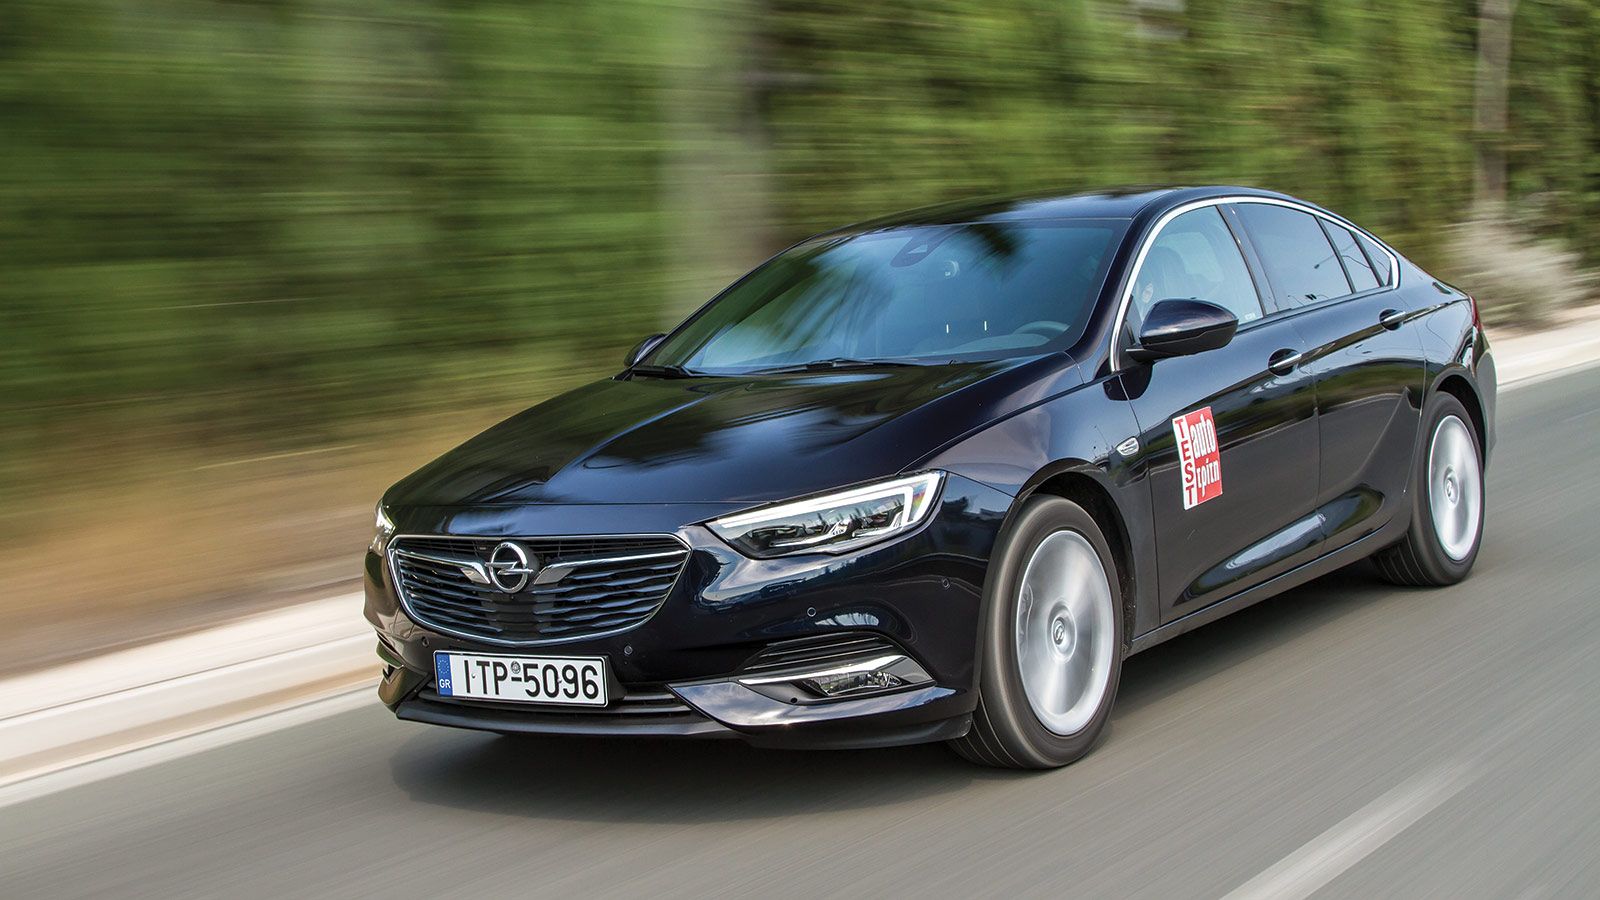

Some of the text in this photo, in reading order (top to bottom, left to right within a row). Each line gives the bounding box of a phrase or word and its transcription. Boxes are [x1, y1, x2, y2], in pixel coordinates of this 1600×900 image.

[1190, 413, 1216, 459] auto
[1174, 418, 1195, 505] TEST
[1196, 458, 1220, 497] τρίτη
[439, 678, 451, 689] GR
